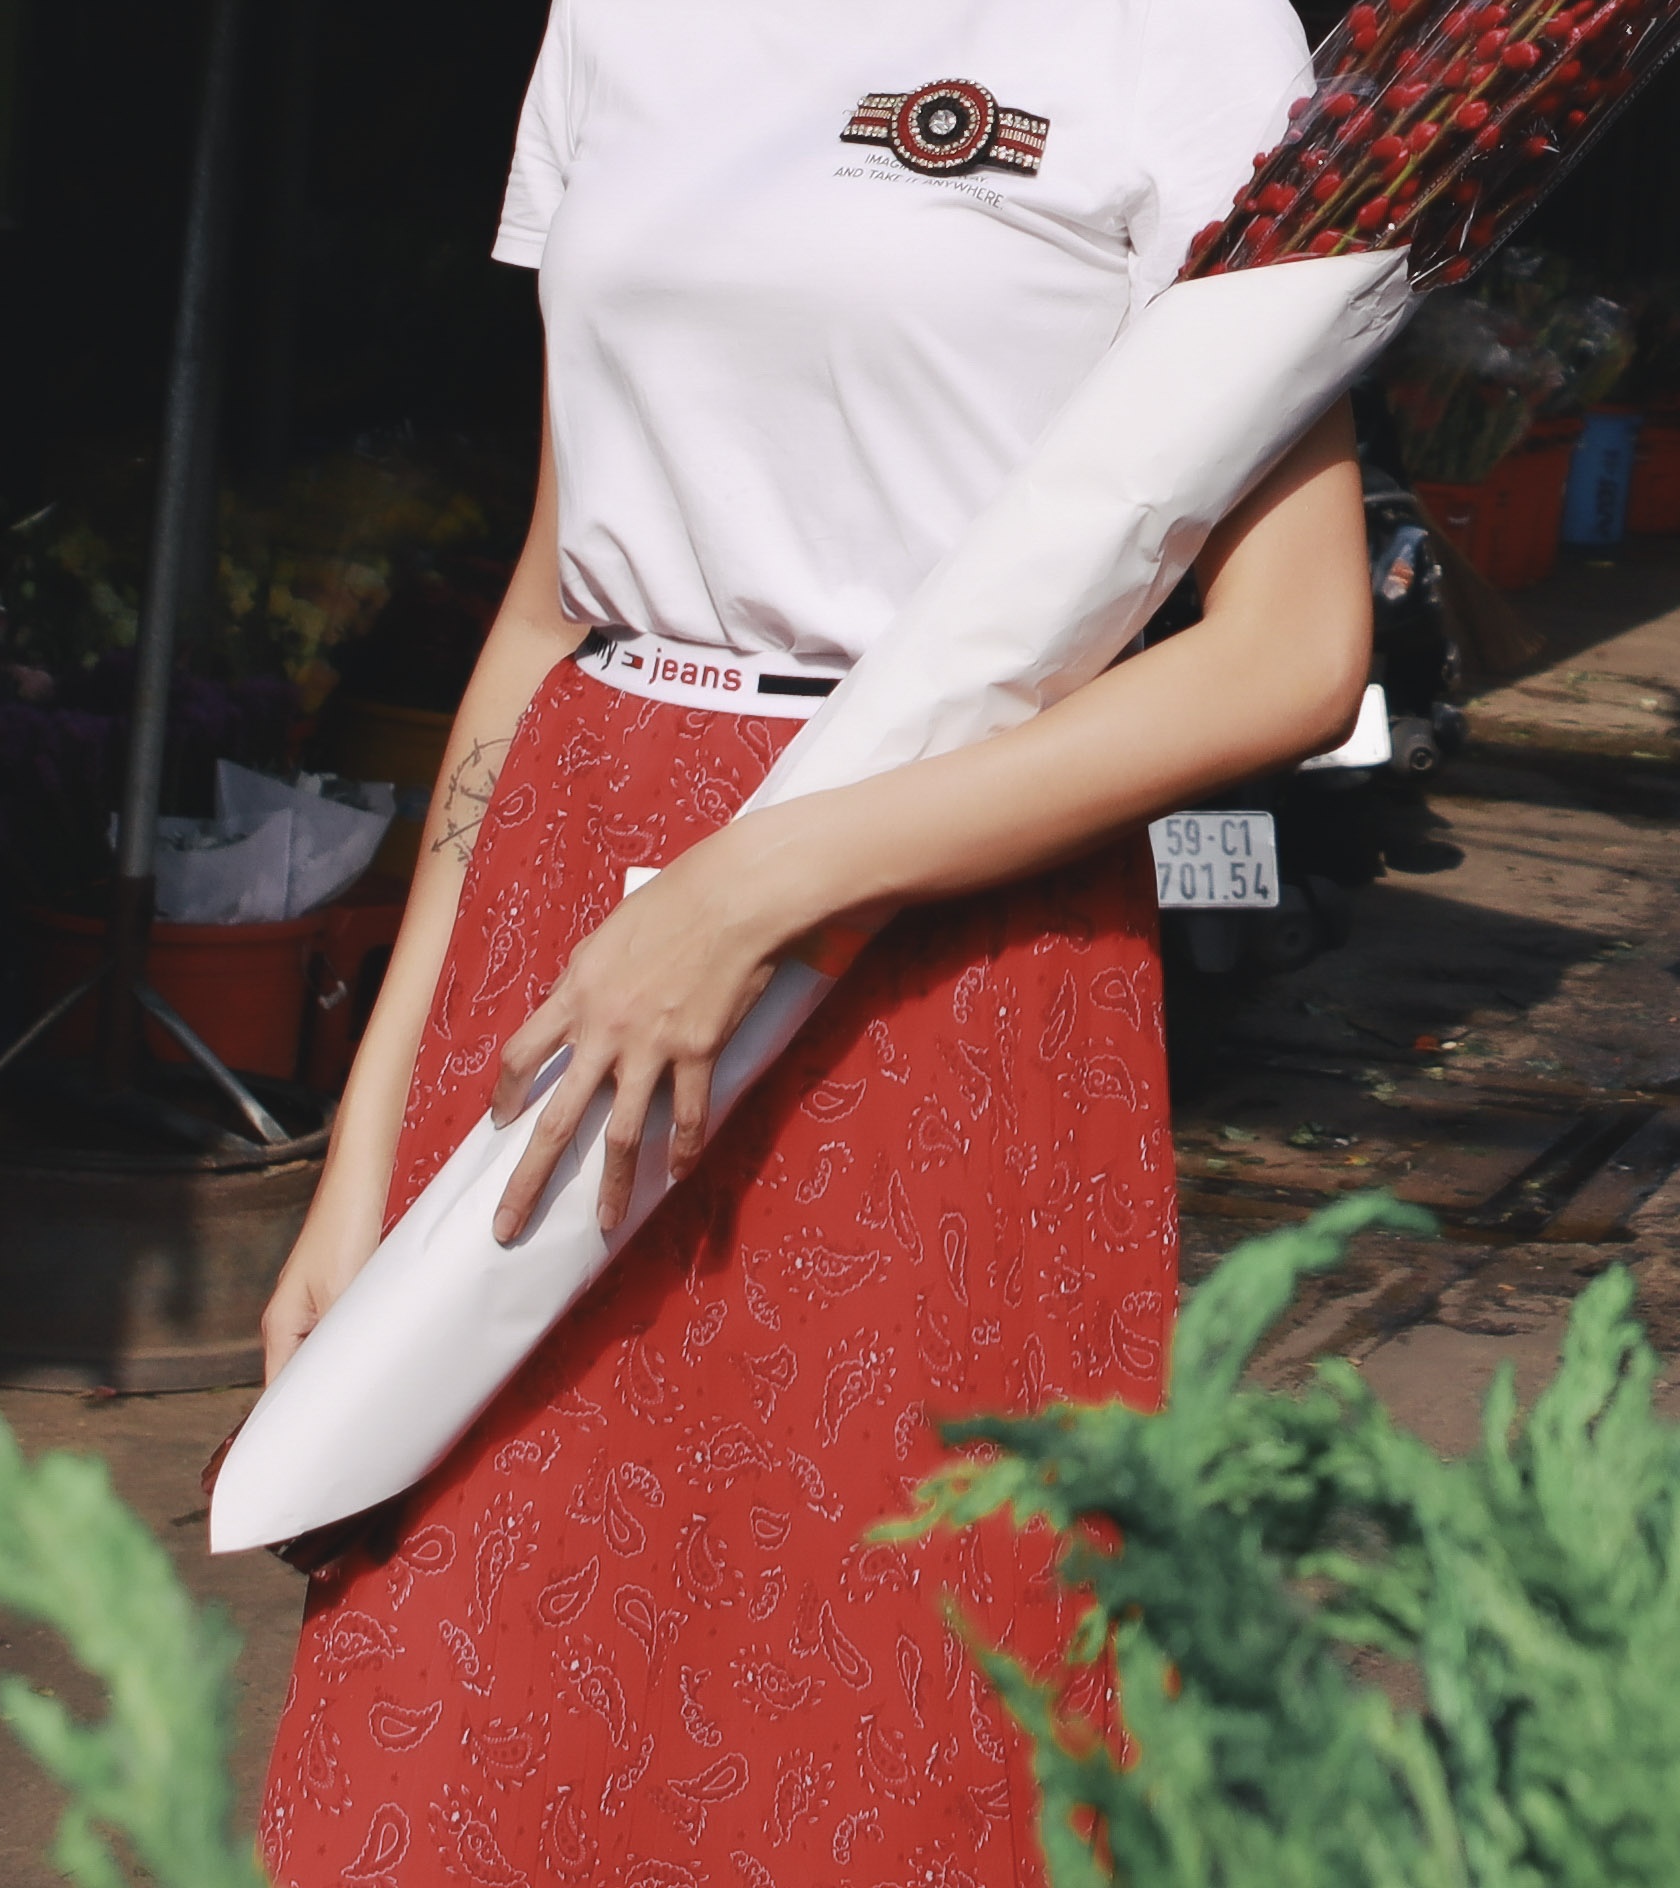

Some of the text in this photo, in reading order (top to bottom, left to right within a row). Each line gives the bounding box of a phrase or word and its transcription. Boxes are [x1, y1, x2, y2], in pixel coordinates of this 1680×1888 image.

[834, 166, 864, 178] AND
[648, 647, 743, 692] jeans
[1165, 818, 1252, 857] 59-C1
[1157, 862, 1270, 900] 701.54
